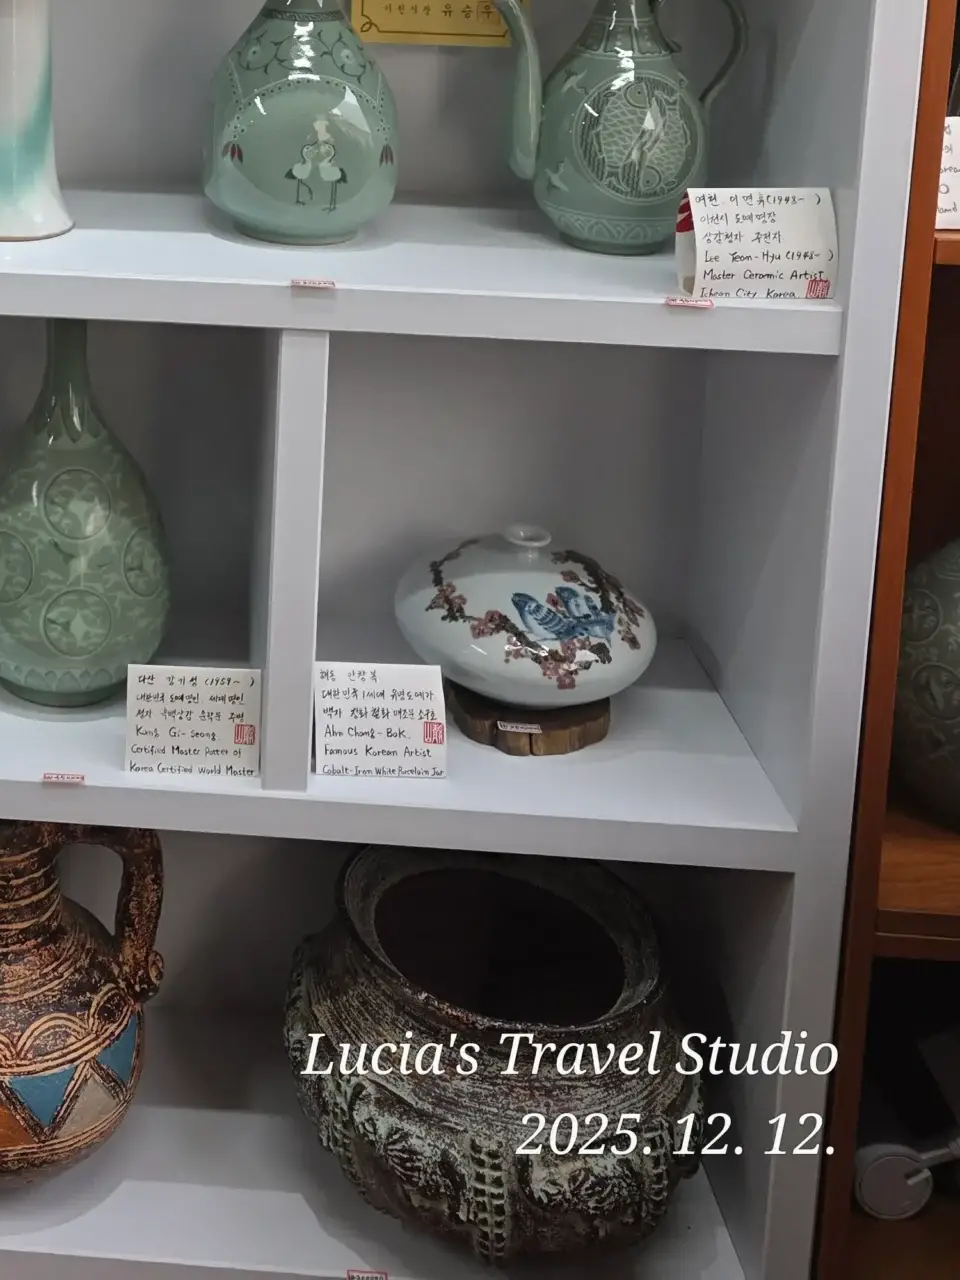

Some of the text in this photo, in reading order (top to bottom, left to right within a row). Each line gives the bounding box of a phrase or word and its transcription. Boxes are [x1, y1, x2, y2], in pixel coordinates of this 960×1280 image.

[700, 215, 728, 225] 이천시
[752, 231, 782, 243] 주전자
[705, 251, 720, 262] Lee
[703, 270, 735, 281] Master
[744, 270, 783, 280] Ceramic
[736, 288, 756, 298] City
[323, 706, 342, 719] 백자
[131, 744, 166, 755] Certified
[172, 746, 201, 755] Master
[233, 748, 242, 758] of
[324, 744, 432, 758] Famous Korean Artist
[129, 761, 154, 772] Korea
[226, 766, 255, 776] Master
